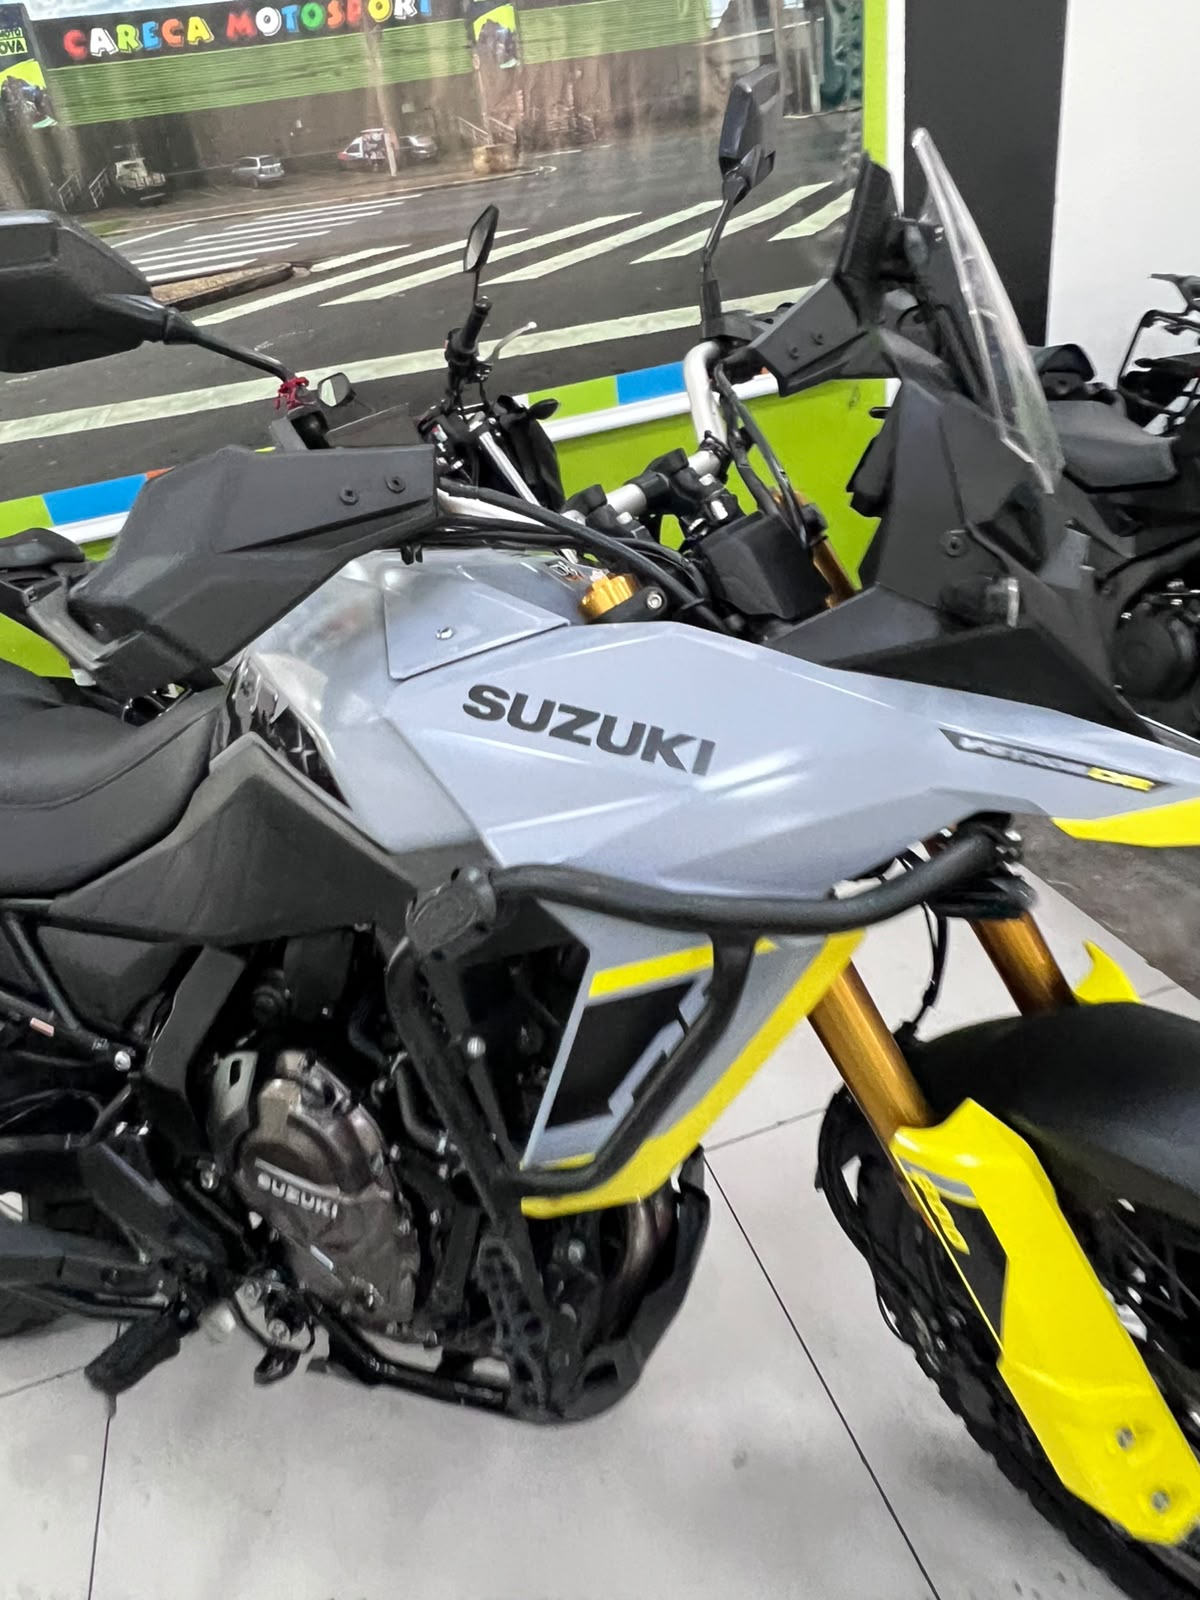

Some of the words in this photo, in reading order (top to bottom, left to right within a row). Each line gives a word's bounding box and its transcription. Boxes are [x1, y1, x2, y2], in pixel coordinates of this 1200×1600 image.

[63, 17, 214, 59] CARECA
[462, 684, 716, 776] SUZUKI
[257, 1173, 338, 1219] SUZUKI
